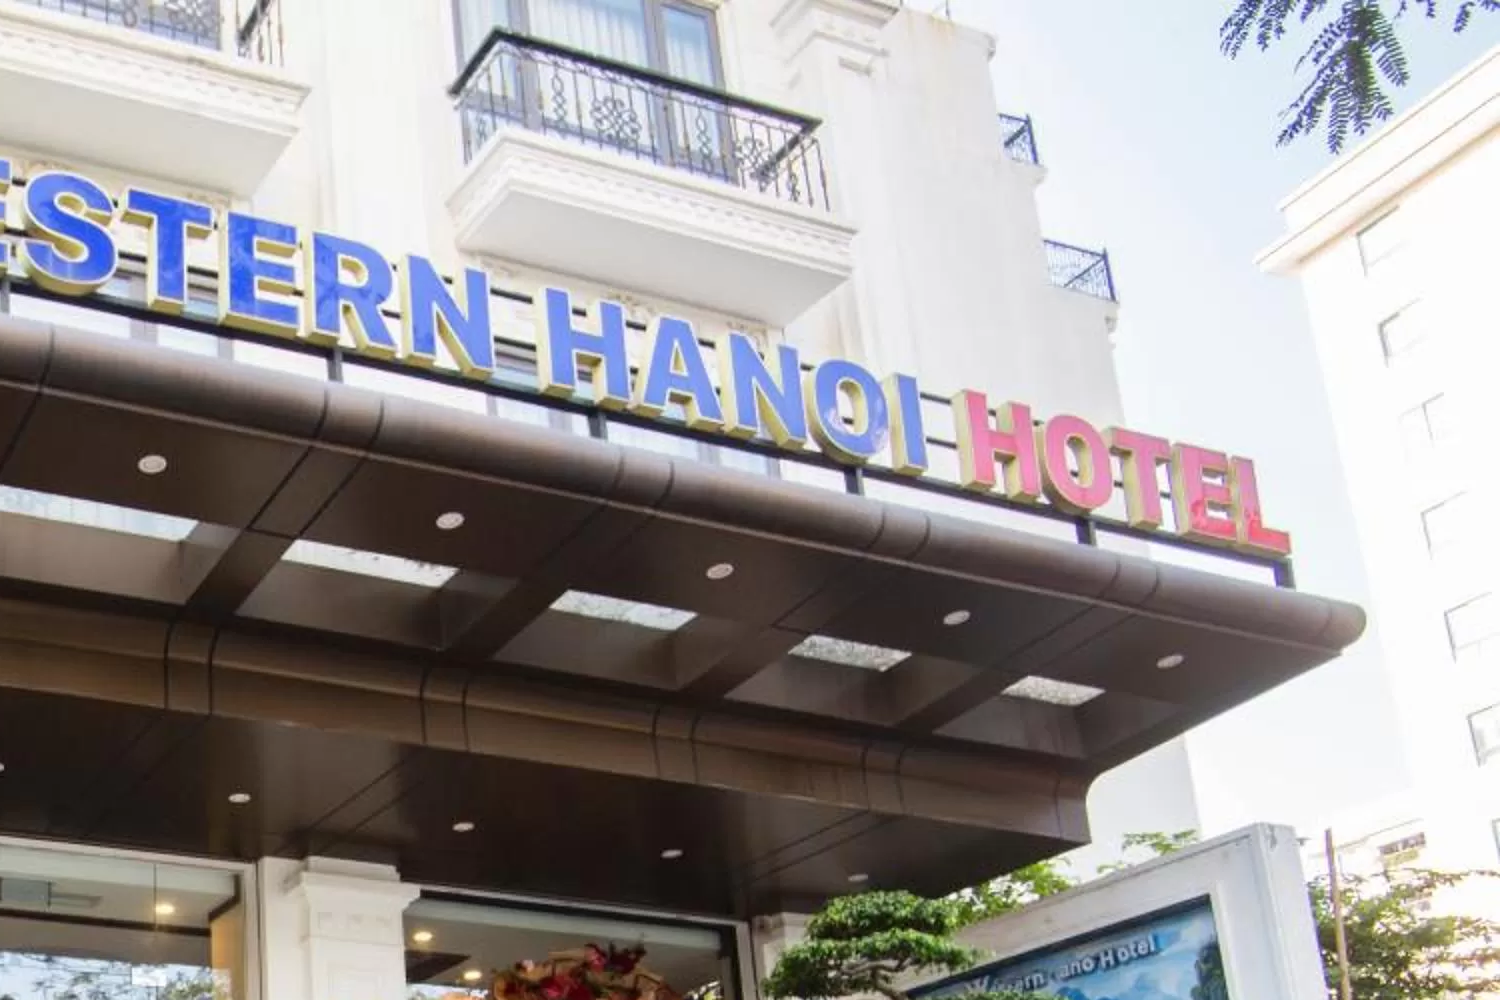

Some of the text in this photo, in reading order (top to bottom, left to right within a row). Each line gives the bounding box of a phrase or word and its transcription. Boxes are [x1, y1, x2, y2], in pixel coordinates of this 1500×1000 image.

[537, 285, 928, 477] HANOI
[952, 387, 1292, 557] HOTEL
[1100, 933, 1156, 969] Hotel
